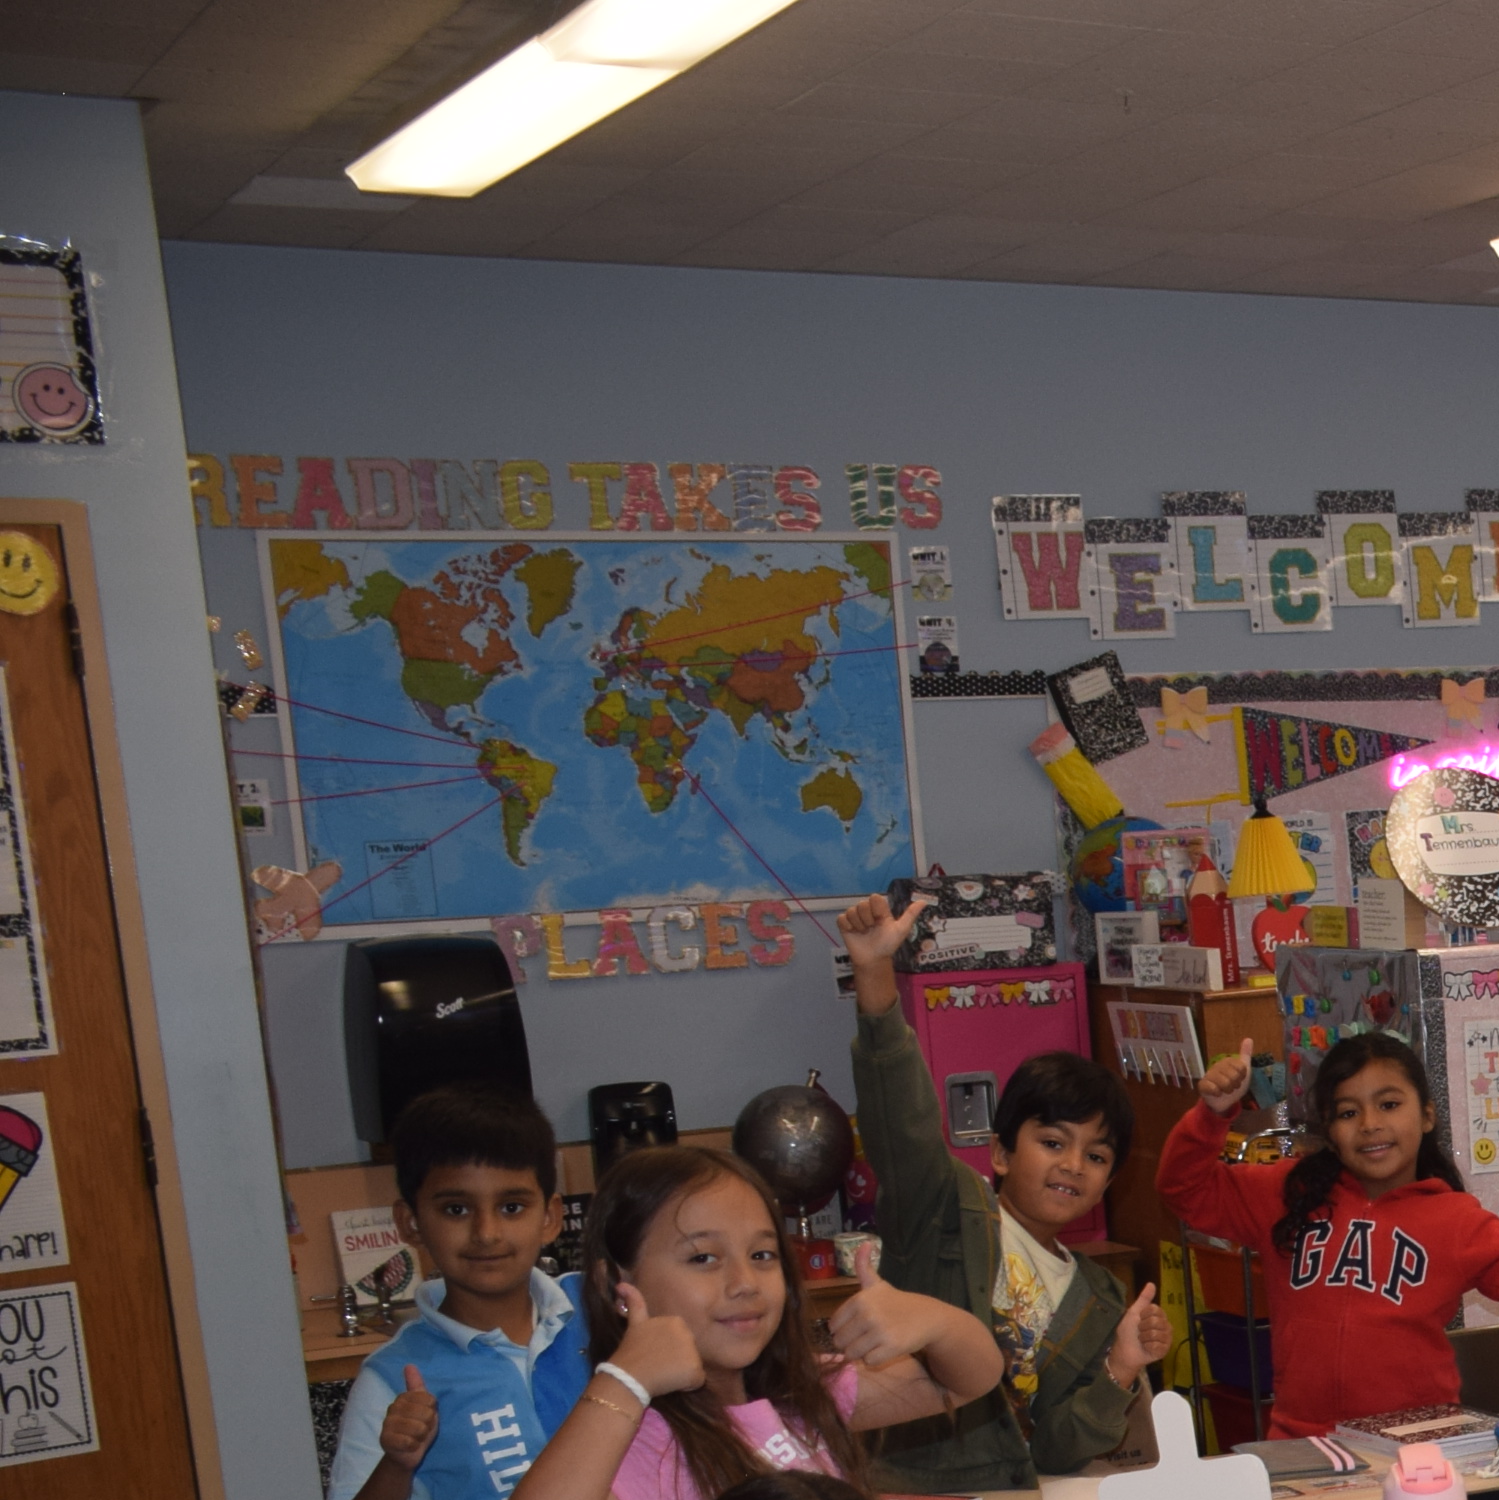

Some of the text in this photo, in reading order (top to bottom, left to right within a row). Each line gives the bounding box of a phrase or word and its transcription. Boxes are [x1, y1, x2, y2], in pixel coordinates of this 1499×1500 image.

[187, 453, 943, 532] READING TAKES US
[1246, 716, 1393, 792] WELCOME
[1440, 814, 1476, 835] Mrs.
[368, 843, 427, 854] The World
[489, 900, 796, 984] PLACES
[920, 945, 976, 963] POSITIVE
[435, 996, 464, 1019] Scott
[344, 1229, 399, 1252] SMILIN
[1289, 1218, 1429, 1305] GAP
[0, 1299, 44, 1346] OU
[0, 1366, 60, 1415] his
